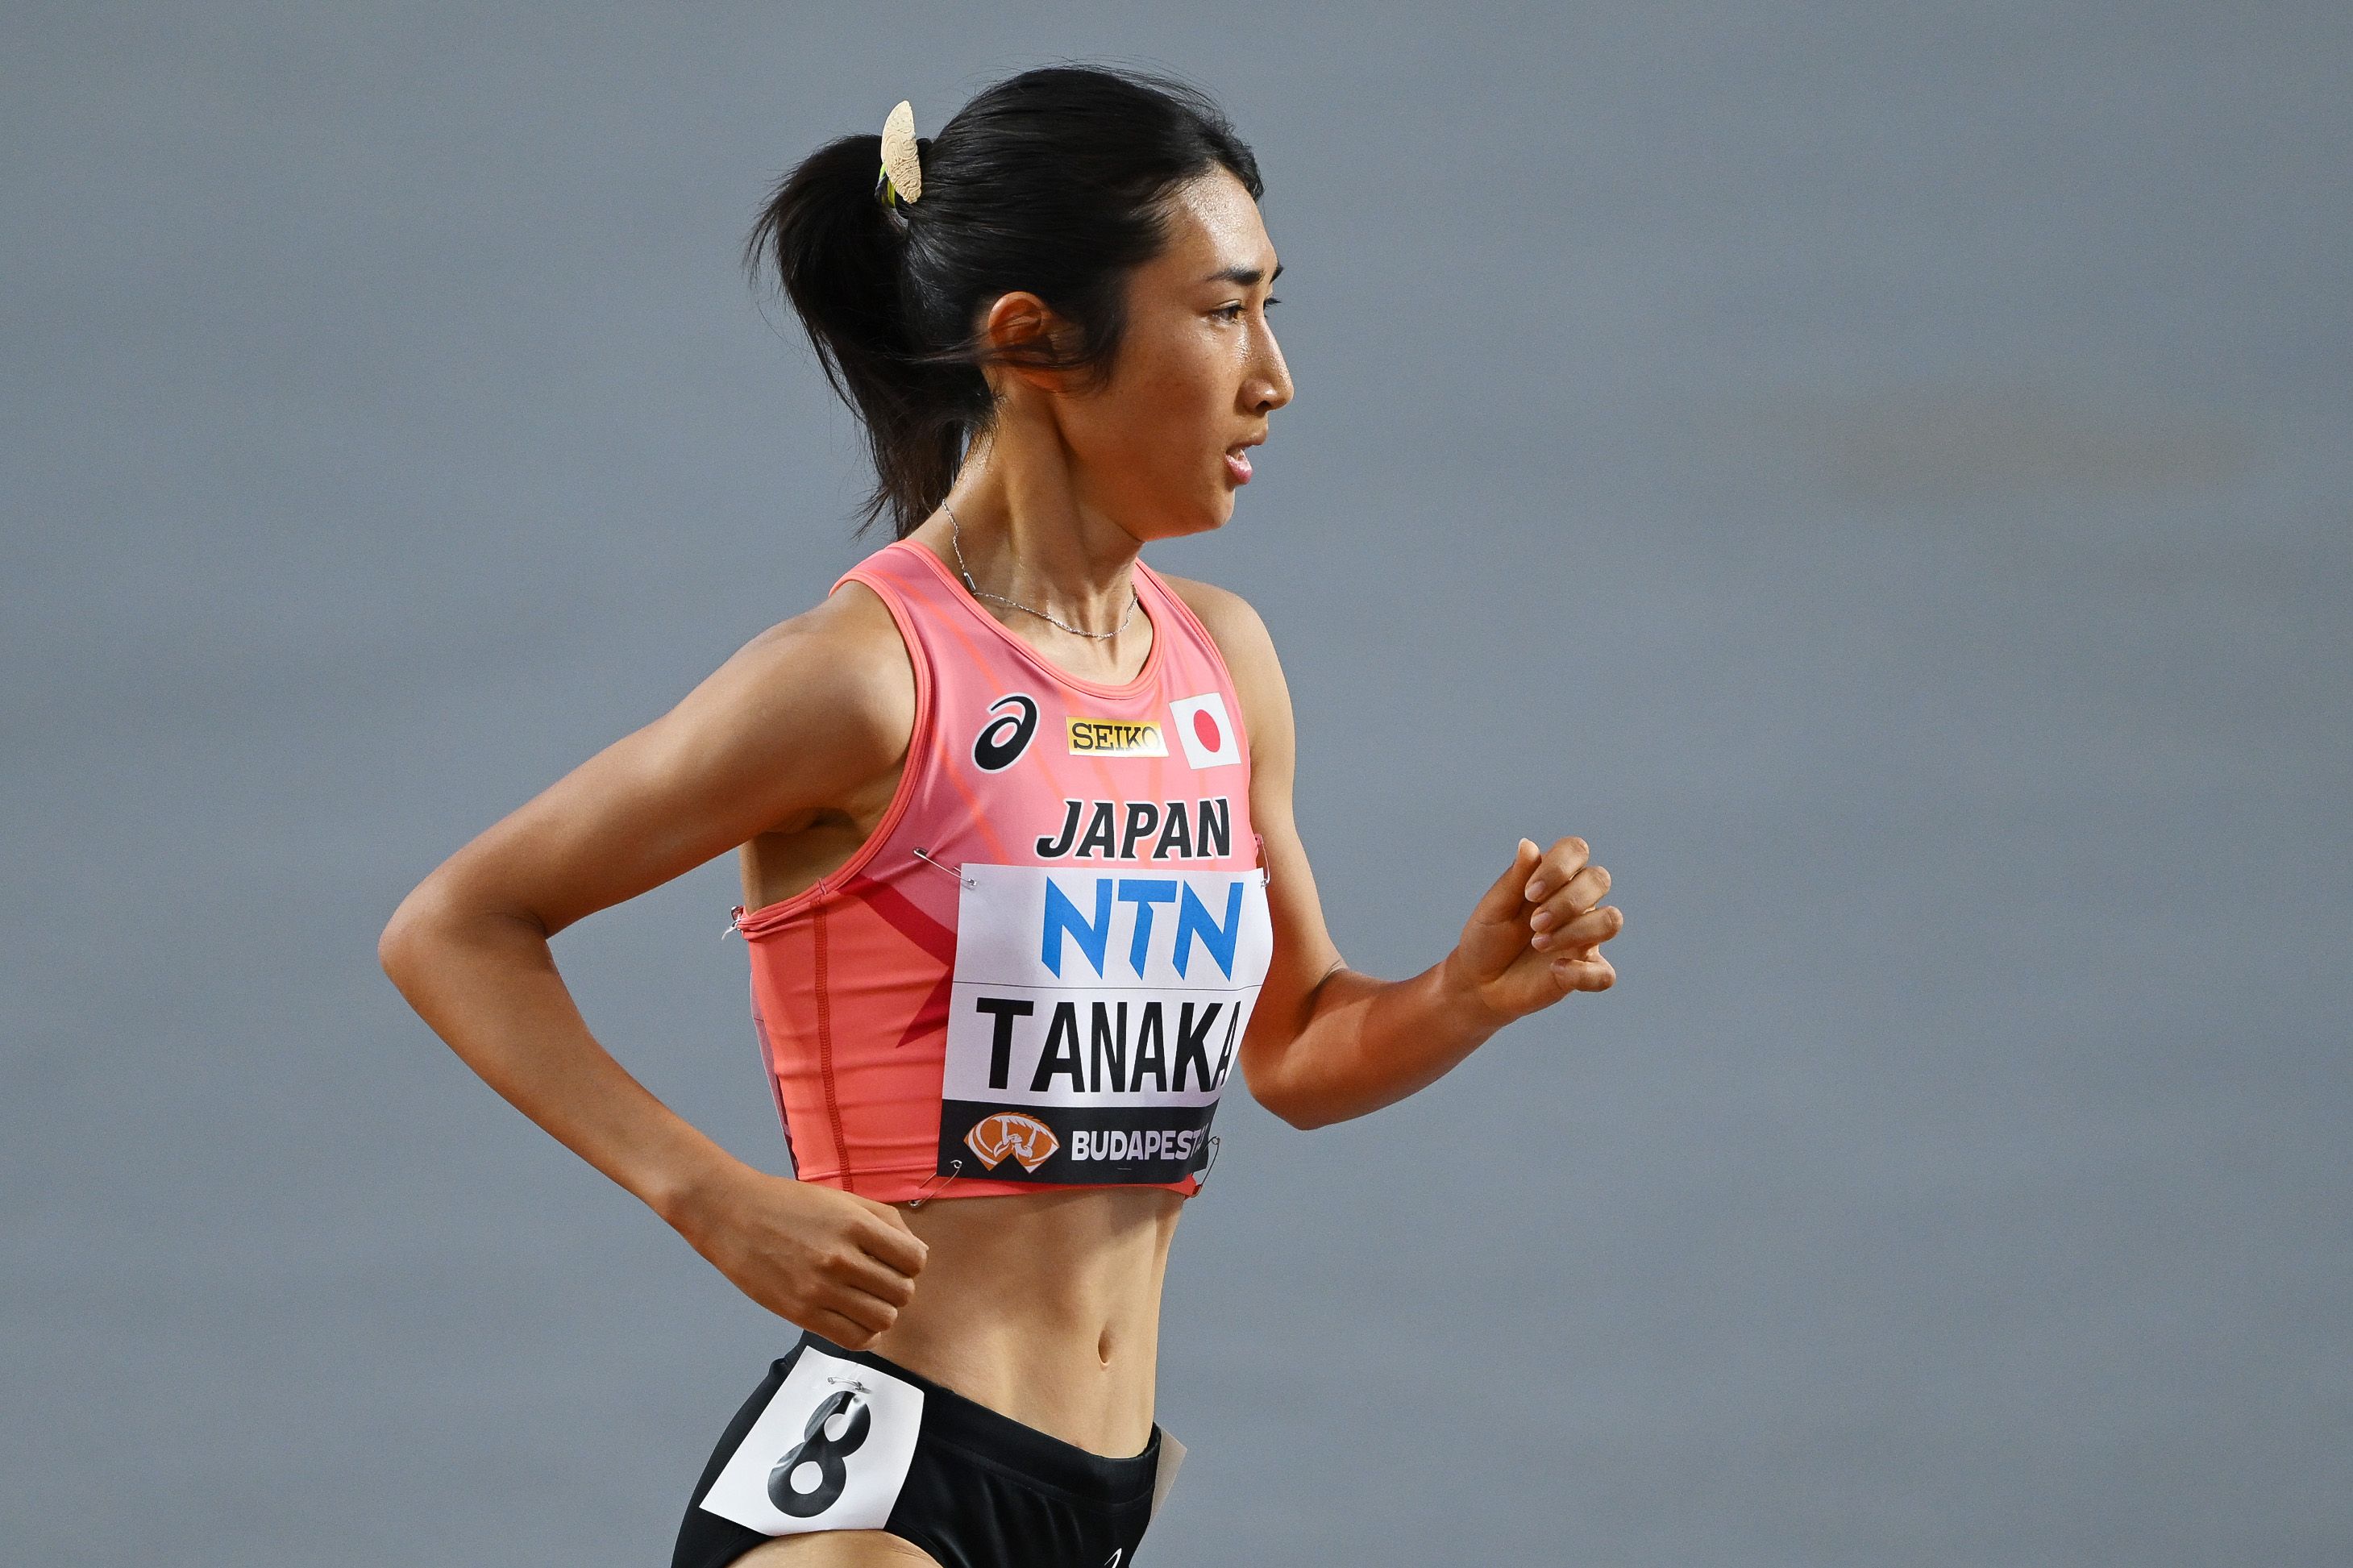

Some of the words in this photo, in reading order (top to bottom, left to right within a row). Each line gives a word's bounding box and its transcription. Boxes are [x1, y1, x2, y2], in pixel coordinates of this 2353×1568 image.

[1071, 722, 1161, 751] SEIKO
[1035, 797, 1232, 860] JAPAN
[1041, 876, 1244, 982] NTN
[976, 997, 1241, 1093] TANAKA
[767, 1391, 871, 1518] 8
